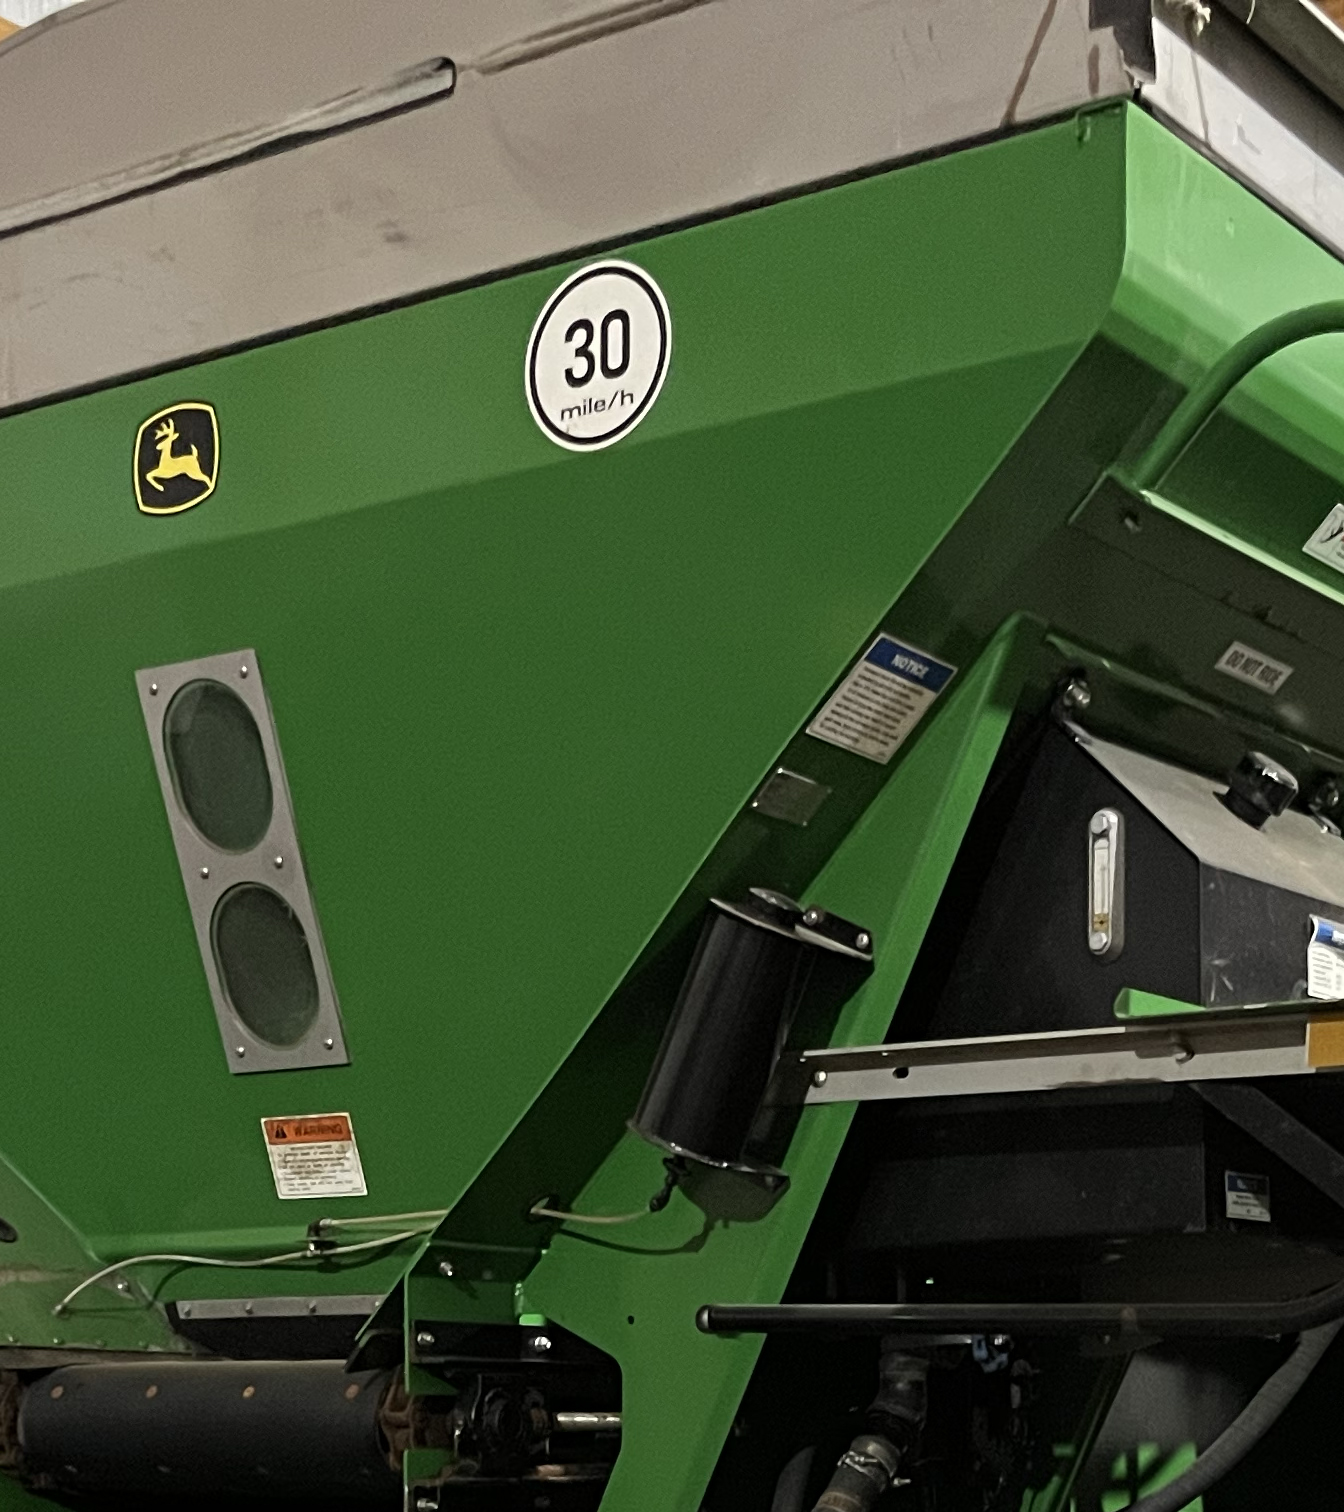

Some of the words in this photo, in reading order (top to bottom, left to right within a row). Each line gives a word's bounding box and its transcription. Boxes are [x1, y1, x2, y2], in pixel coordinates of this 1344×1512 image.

[564, 308, 631, 388] 30
[560, 390, 634, 421] mile/h
[891, 653, 930, 680] NOTICE
[294, 1122, 344, 1137] WARNING
